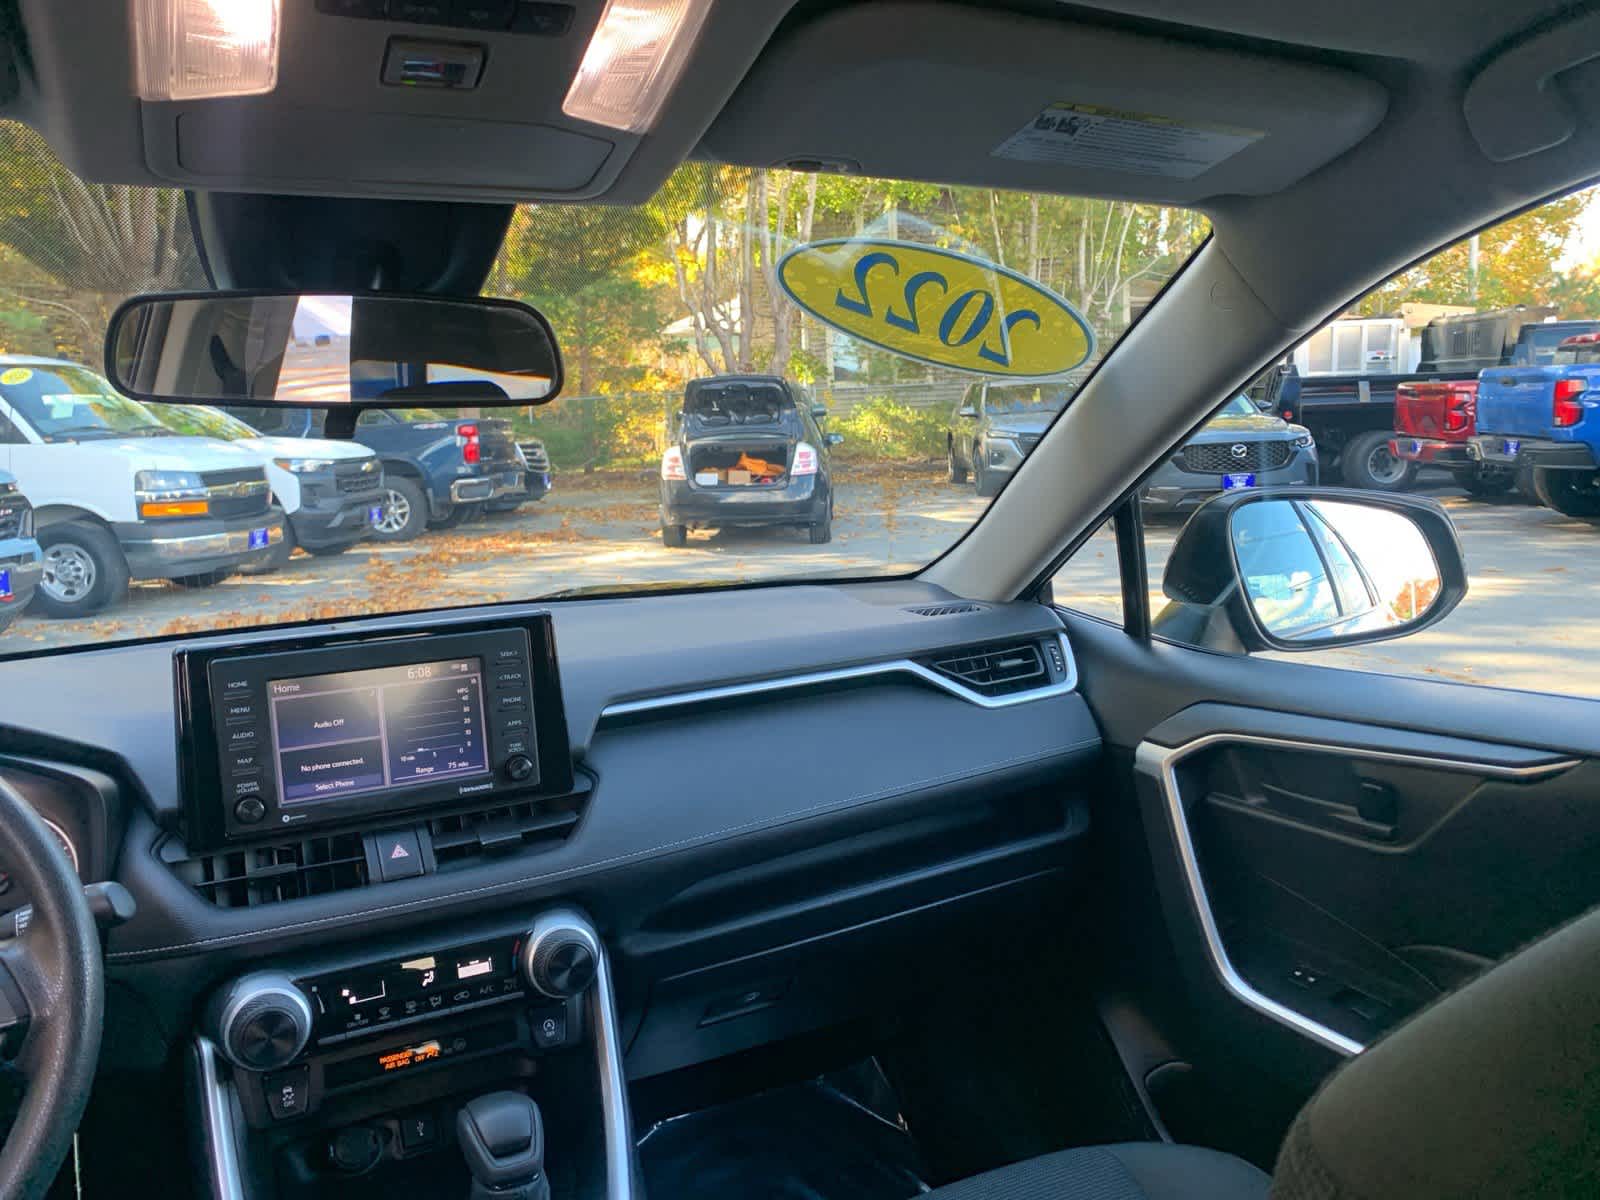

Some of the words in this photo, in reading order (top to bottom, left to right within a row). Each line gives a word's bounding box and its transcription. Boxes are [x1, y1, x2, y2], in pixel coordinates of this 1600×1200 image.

[407, 666, 432, 679] 6:08
[228, 680, 248, 688] HOME
[273, 684, 300, 694] Home
[502, 696, 521, 704] PHONE
[230, 706, 250, 714] MENU
[333, 718, 344, 726] Off
[232, 731, 254, 740] AUDIO
[237, 757, 253, 765] MAP
[312, 763, 331, 772] phone
[332, 757, 363, 768] connected
[448, 761, 457, 769] 75
[236, 786, 260, 794] VOLUME
[315, 783, 334, 791] Select
[335, 780, 354, 788] Phone
[480, 985, 495, 994] A/C
[379, 1049, 413, 1064] PASSENGER
[385, 1061, 396, 1070] AIR
[397, 1058, 411, 1067] BAG
[415, 1054, 425, 1062] OFF
